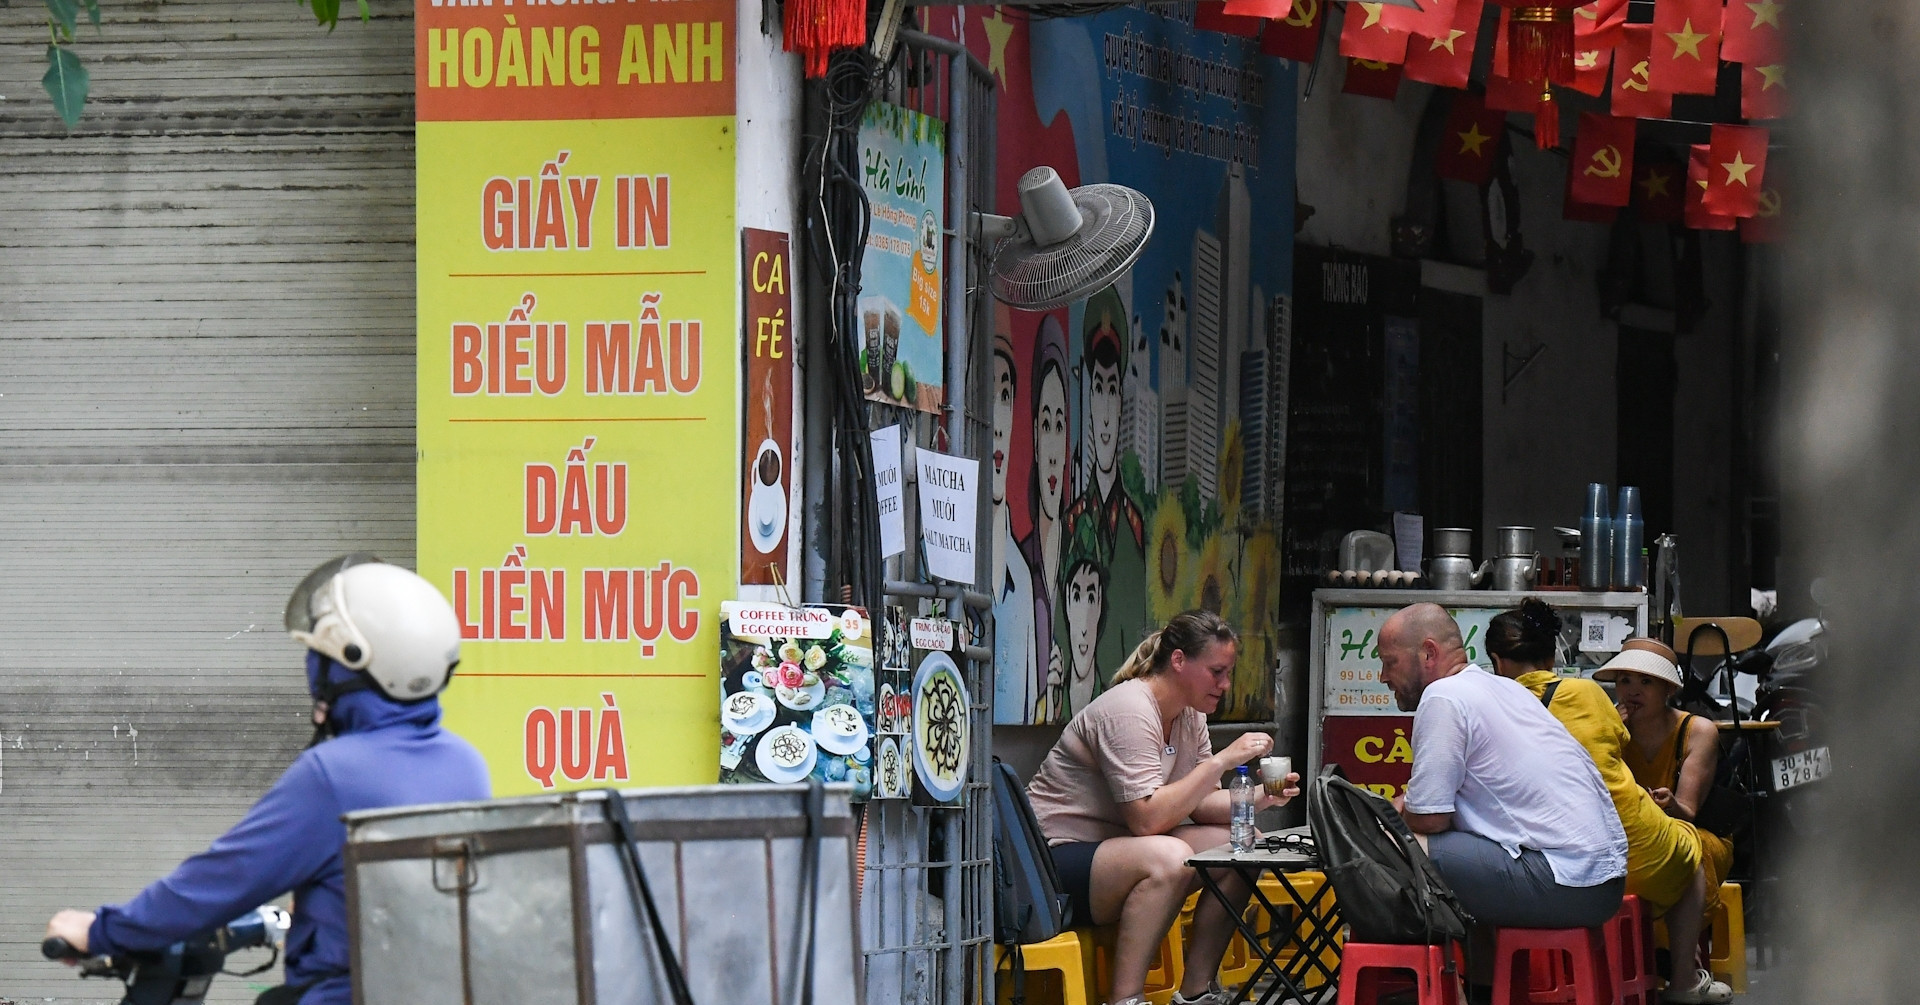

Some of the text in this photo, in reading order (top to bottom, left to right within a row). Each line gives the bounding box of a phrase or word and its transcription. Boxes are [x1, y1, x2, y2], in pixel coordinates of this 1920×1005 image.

[428, 14, 723, 88] HOÀNG ANH
[865, 147, 928, 204] Hà Linh
[482, 152, 669, 250] GIẤY IN
[898, 210, 917, 230] Phong
[753, 251, 785, 295] CA
[912, 266, 937, 302] Big size
[919, 295, 930, 317] 15k
[452, 293, 702, 395] BIỂU MẪU
[755, 308, 785, 359] FÉ
[525, 437, 627, 535] DẤU
[924, 464, 965, 491] MATCHA
[926, 528, 971, 554] SALT MATCHA
[453, 545, 700, 657] LIỀN MỰC
[740, 609, 785, 621] COFFEE
[845, 619, 859, 631] 35
[915, 638, 927, 648] EGG
[1340, 670, 1354, 681] 99
[1358, 669, 1373, 681] Lê
[1339, 693, 1390, 705] Đt: 0365
[525, 694, 629, 788] QUÀ
[1354, 728, 1413, 764] CÀ
